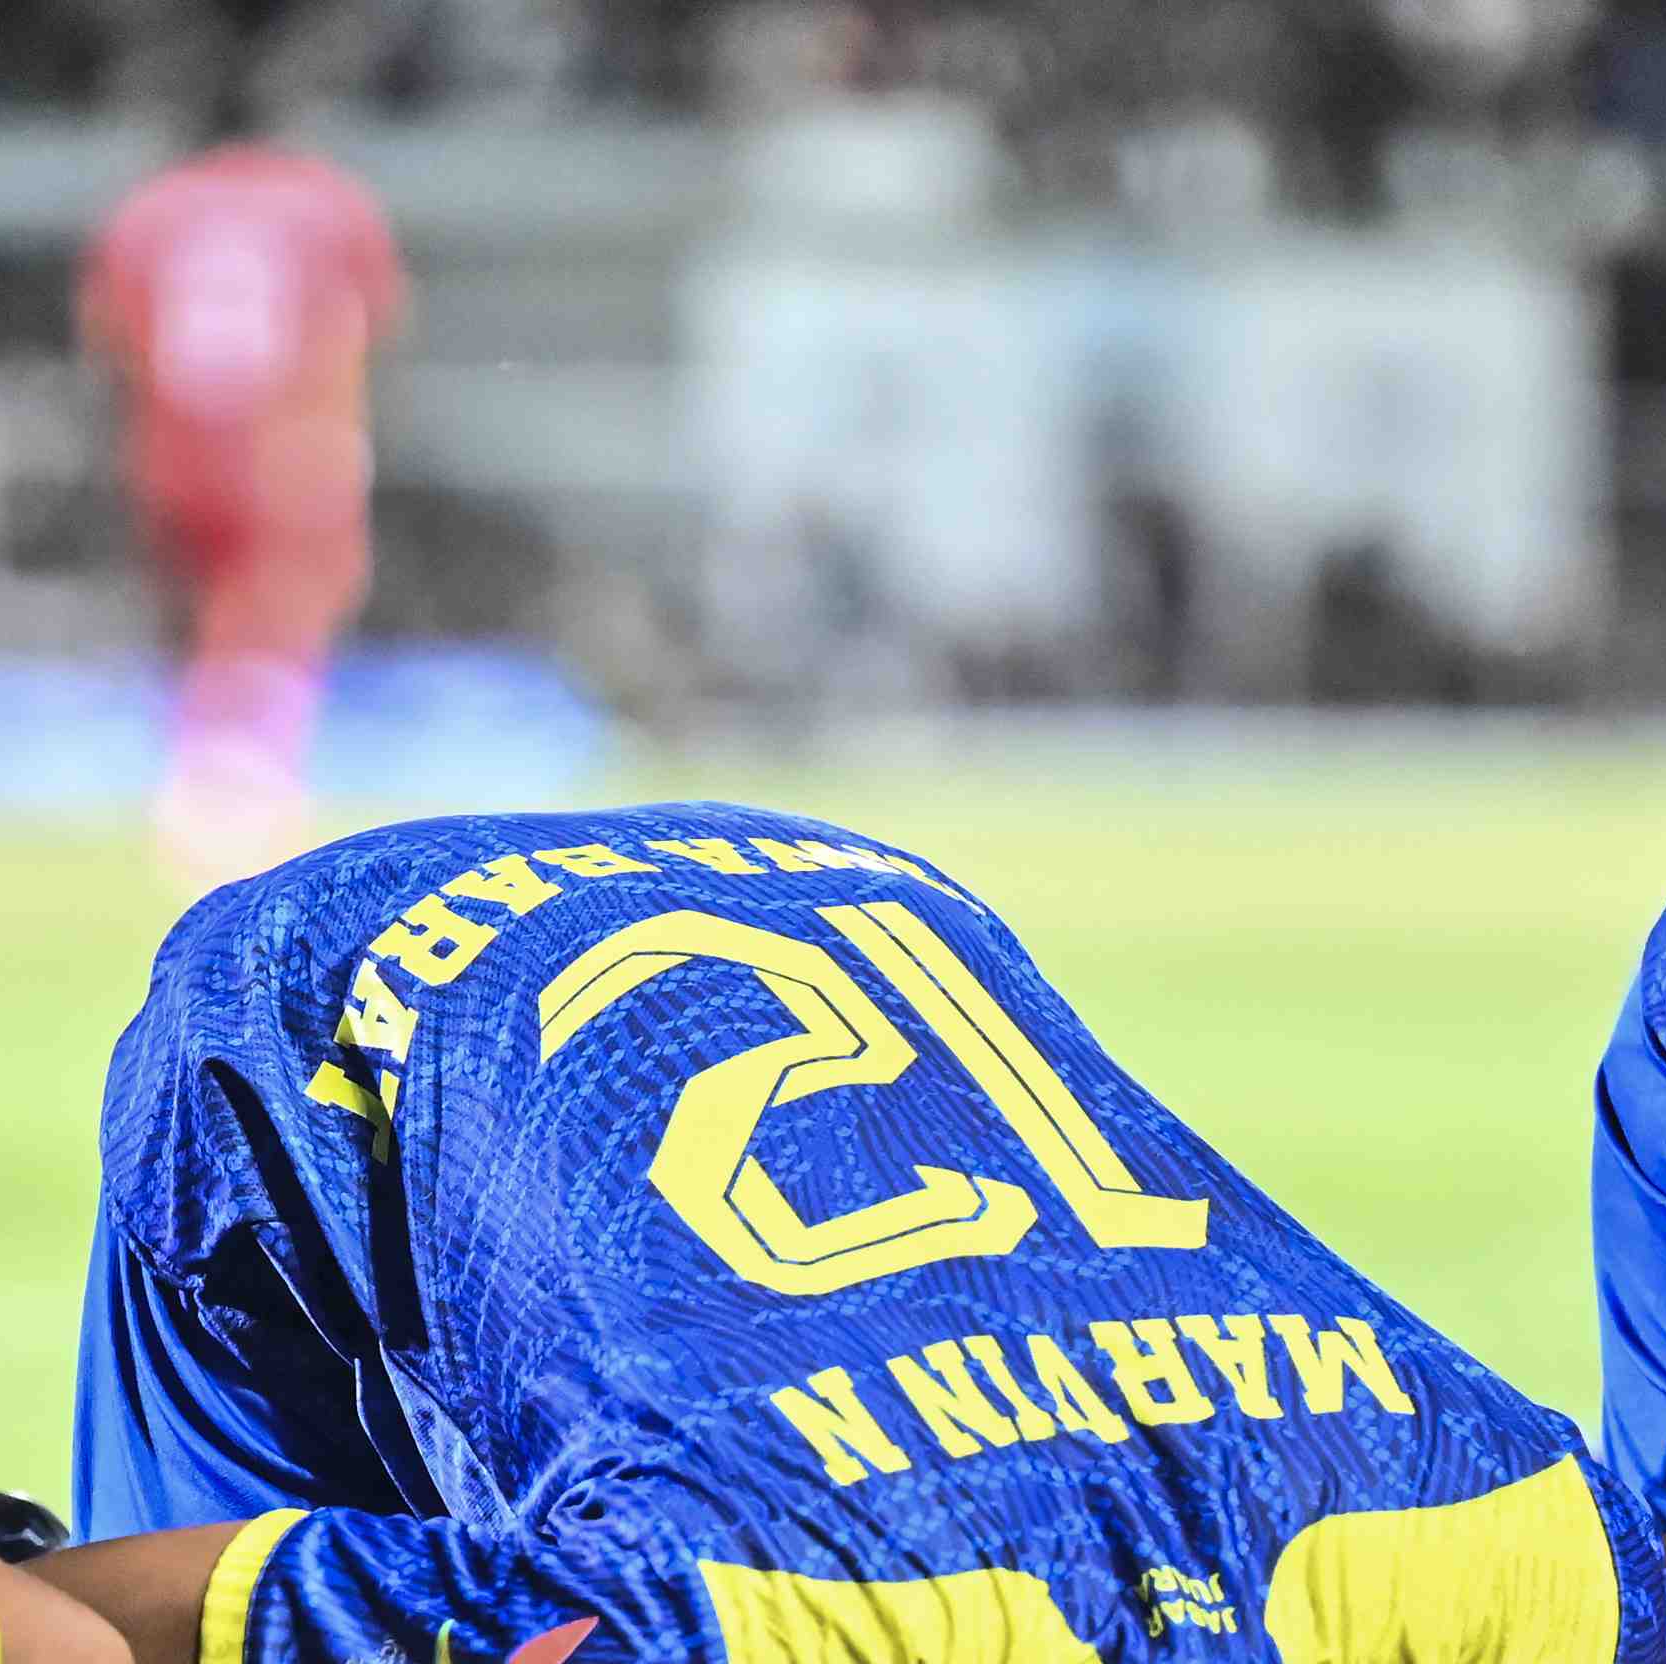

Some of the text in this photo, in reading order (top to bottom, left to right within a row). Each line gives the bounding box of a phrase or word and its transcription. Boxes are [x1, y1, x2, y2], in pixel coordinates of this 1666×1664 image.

[539, 902, 1210, 1296] 12
[768, 1316, 1415, 1487] MARVIN N
